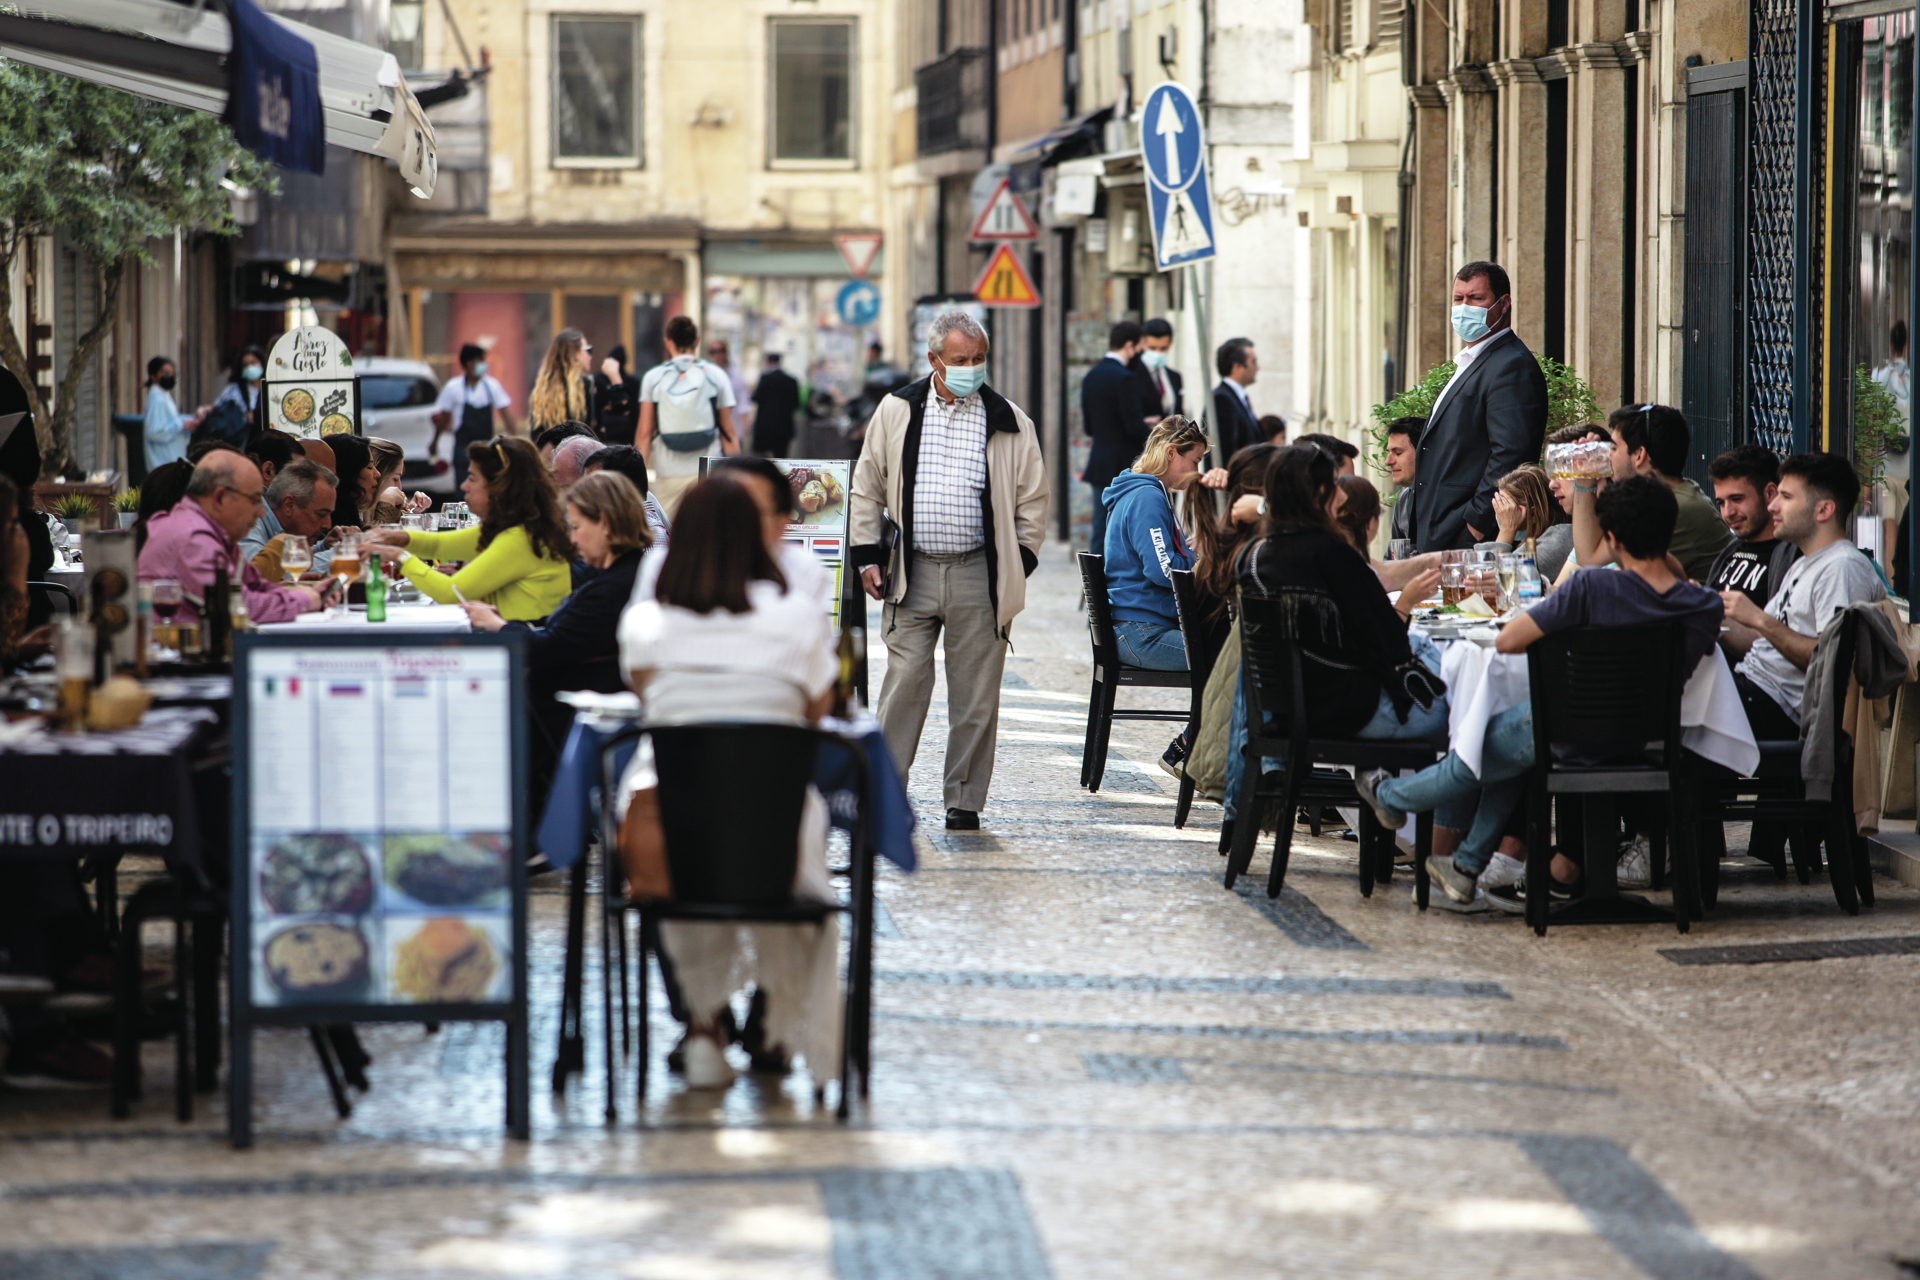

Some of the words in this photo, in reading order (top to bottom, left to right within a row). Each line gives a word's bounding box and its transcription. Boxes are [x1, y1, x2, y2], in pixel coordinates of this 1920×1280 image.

[293, 352, 328, 373] Gosto
[37, 813, 61, 846] O
[64, 813, 174, 846] TRIPEIRO
